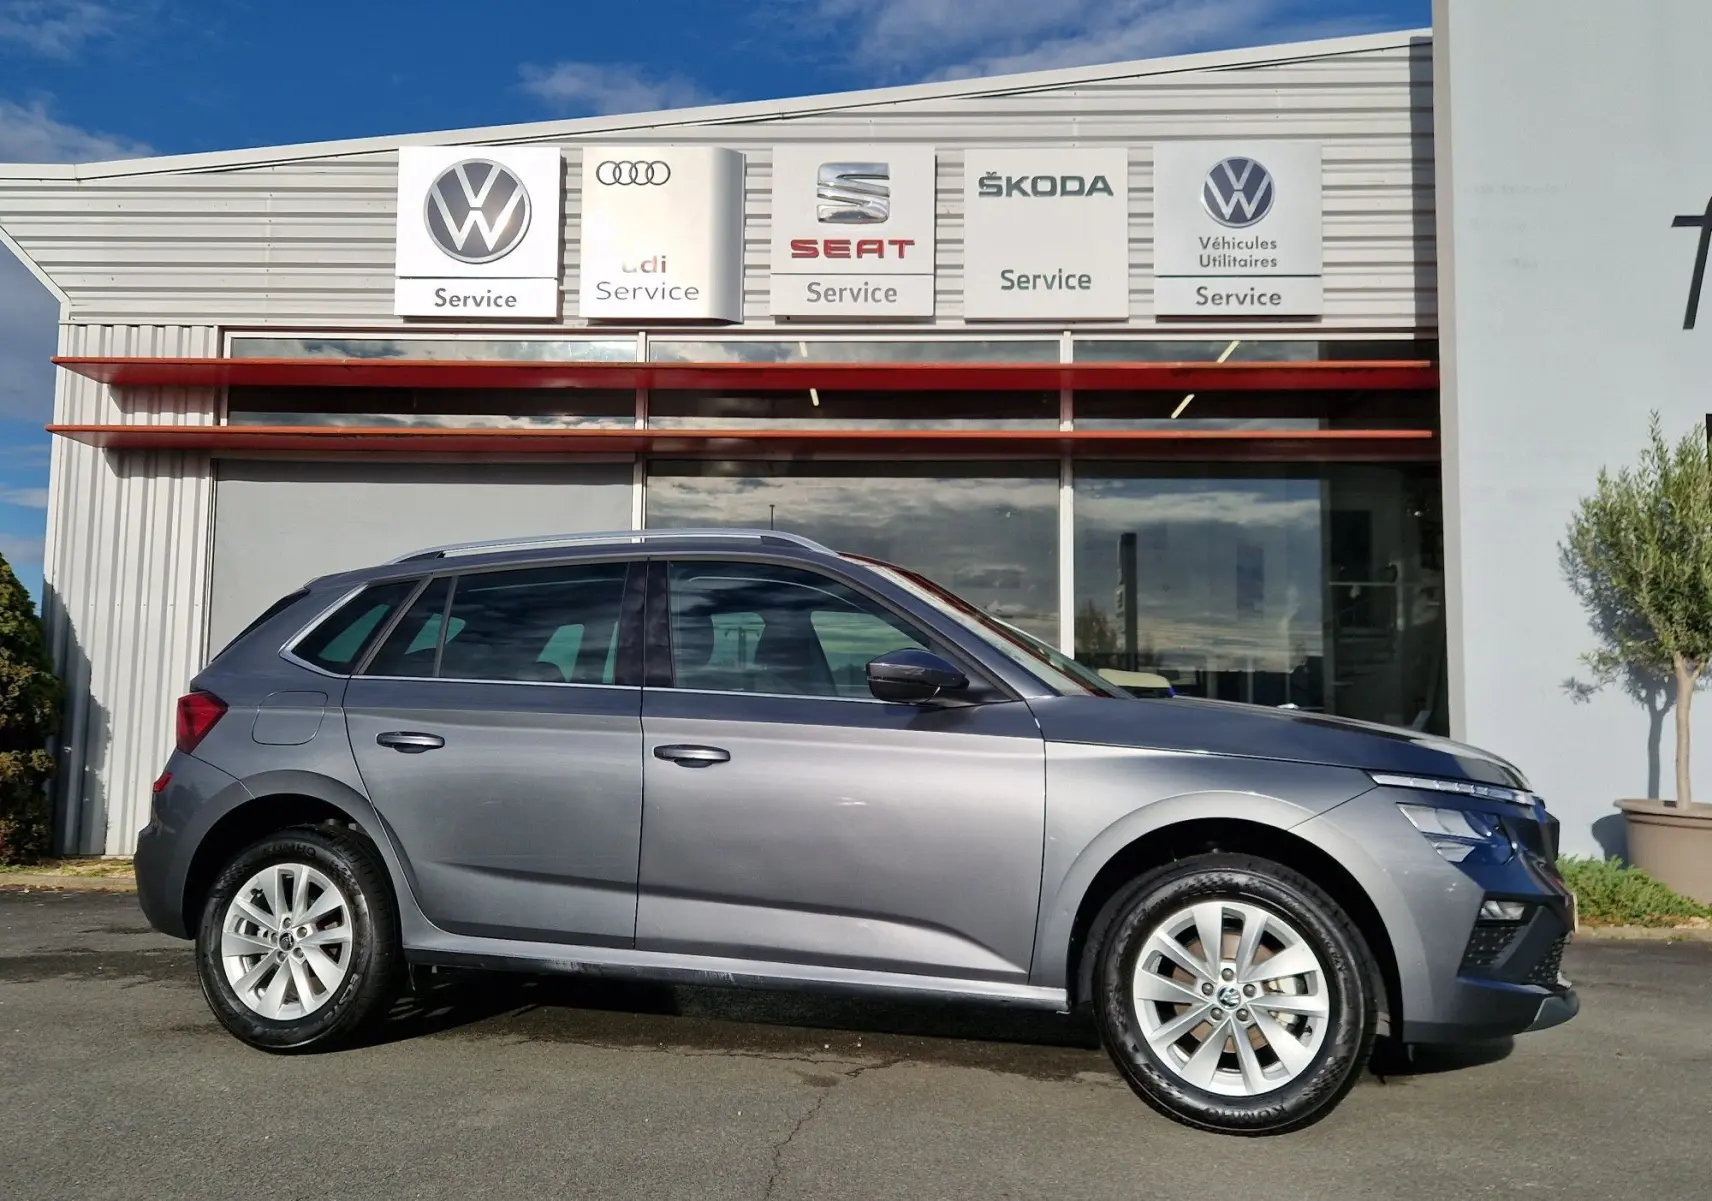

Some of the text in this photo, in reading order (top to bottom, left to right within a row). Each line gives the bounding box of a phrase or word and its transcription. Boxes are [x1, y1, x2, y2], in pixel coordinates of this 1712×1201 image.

[979, 171, 1114, 197] ŠKODA
[790, 239, 915, 259] SEAT
[1199, 236, 1277, 250] Véhicules
[1199, 253, 1277, 268] Utilitaires
[1001, 268, 1092, 290] Service
[434, 288, 517, 308] Service
[596, 280, 700, 301] Service
[806, 281, 898, 303] Service
[1196, 286, 1282, 306] Service
